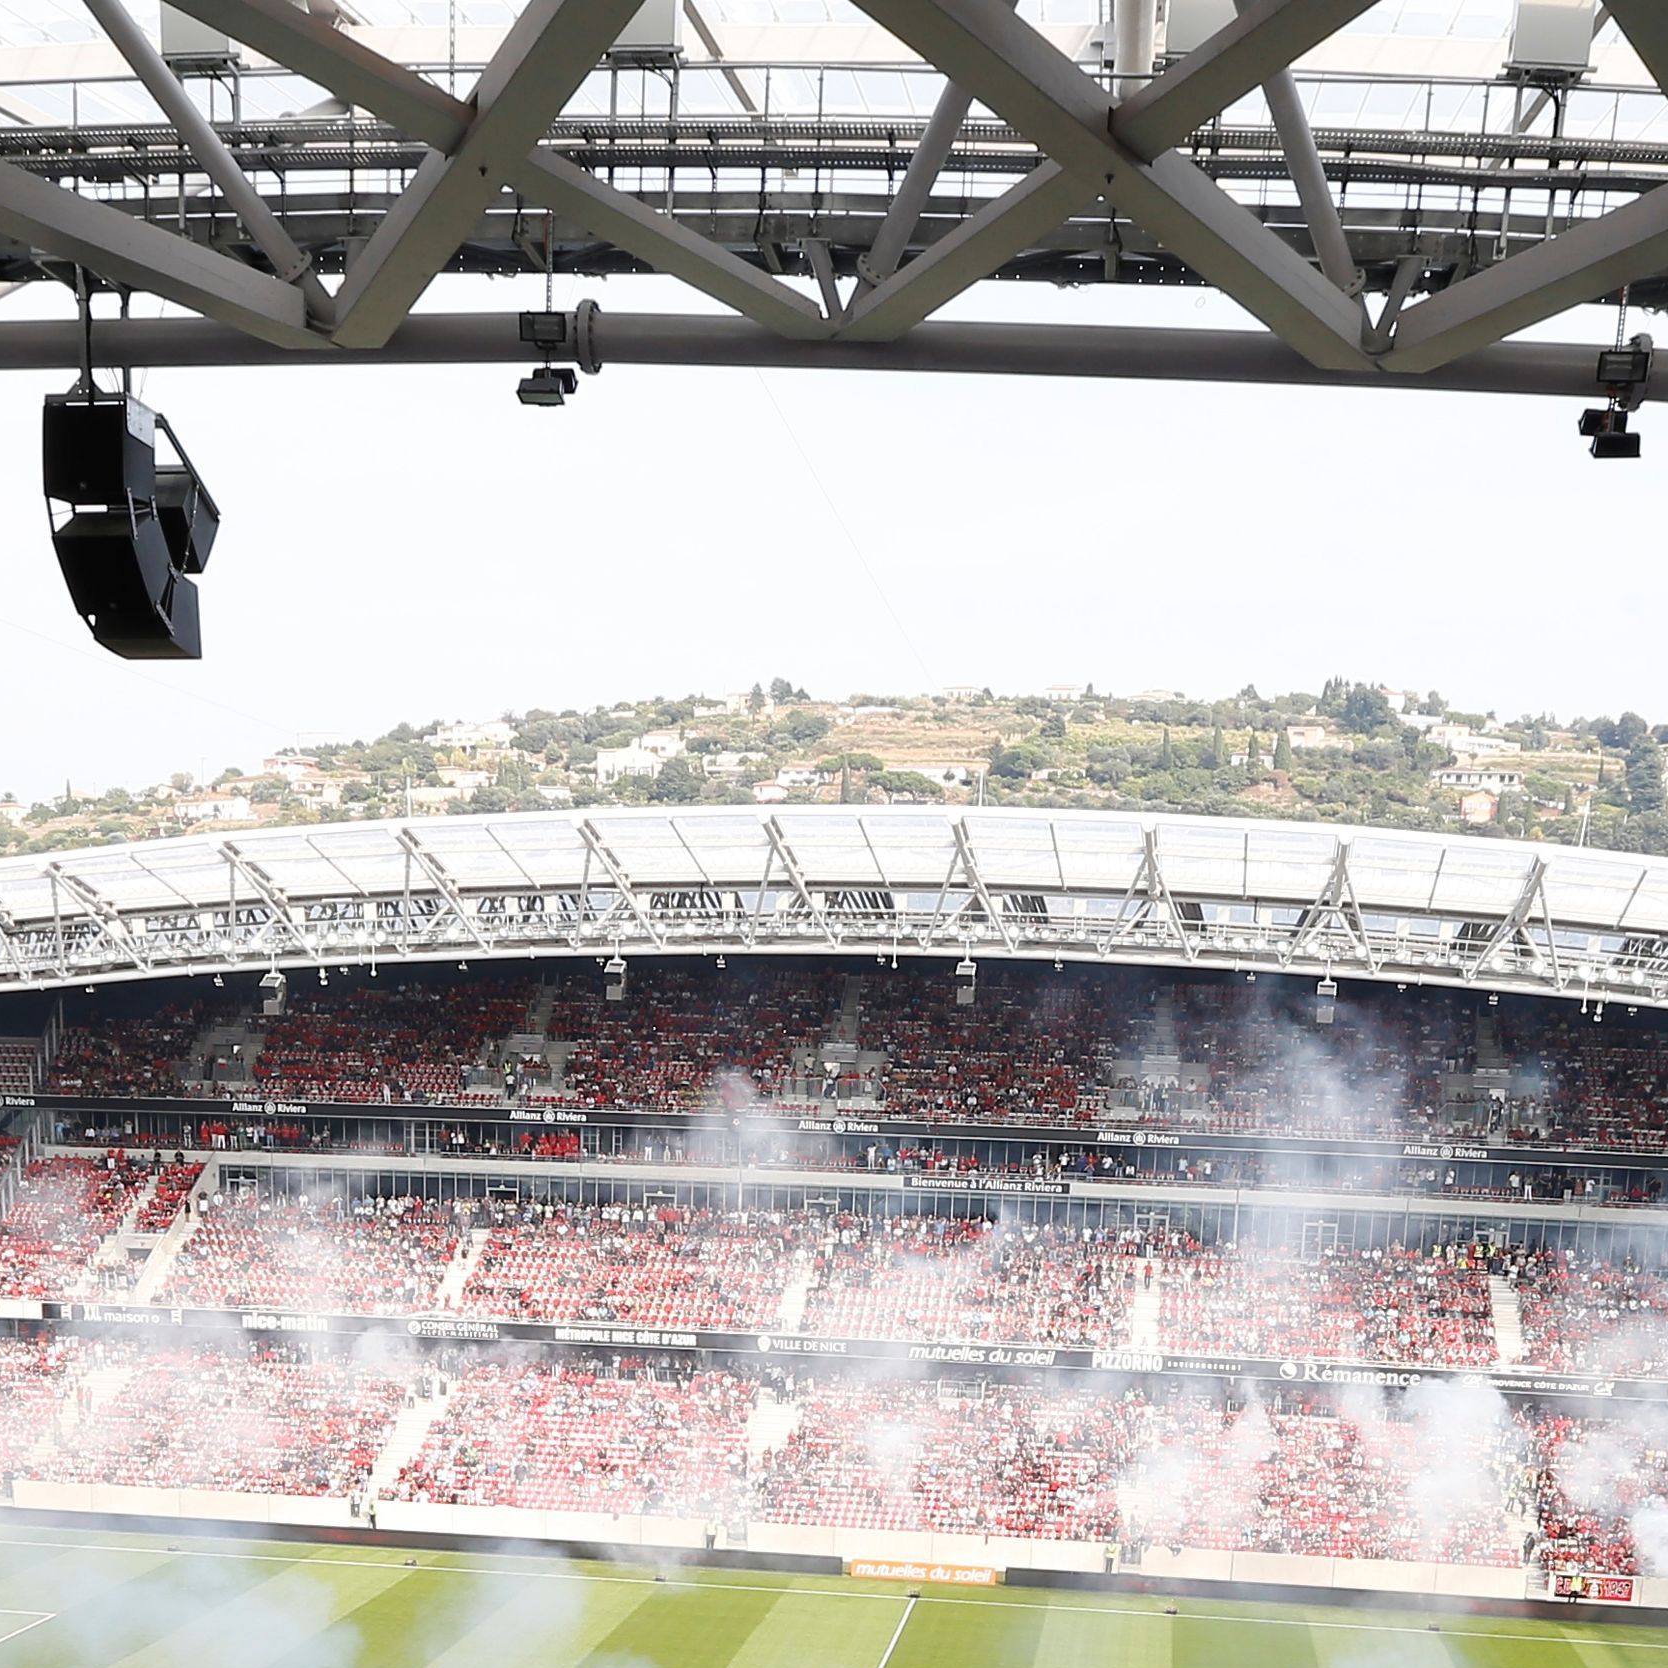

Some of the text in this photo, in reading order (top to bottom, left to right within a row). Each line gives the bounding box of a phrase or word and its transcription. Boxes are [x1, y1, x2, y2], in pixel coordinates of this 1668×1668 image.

[5, 1095, 35, 1108] Riviera
[232, 1101, 307, 1115] Allianz Riviera
[508, 1109, 588, 1123] Allianz Riviera
[798, 1119, 879, 1133] Allianz Riviera
[1097, 1130, 1180, 1146] Allianz Riviera
[1402, 1144, 1488, 1160] Allianz Riviera
[911, 1176, 968, 1189] Bienvenue
[1024, 1180, 1063, 1193] Riviera
[82, 1304, 102, 1323] XXL
[103, 1306, 150, 1324] maison
[242, 1312, 328, 1332] nice-matin
[421, 1320, 456, 1332] CONSEIL
[554, 1326, 697, 1347] MÉTROPOLE NICE CÔTE D'AZUR
[771, 1338, 847, 1353] VILLE DE NICE
[909, 1343, 1056, 1367] mutuelles du soleil
[1091, 1351, 1163, 1372] PIZZORNO
[1302, 1362, 1422, 1387] Rémanence
[1533, 1379, 1557, 1391] CÔTE
[855, 1563, 992, 1583] mutuelles du soleil
